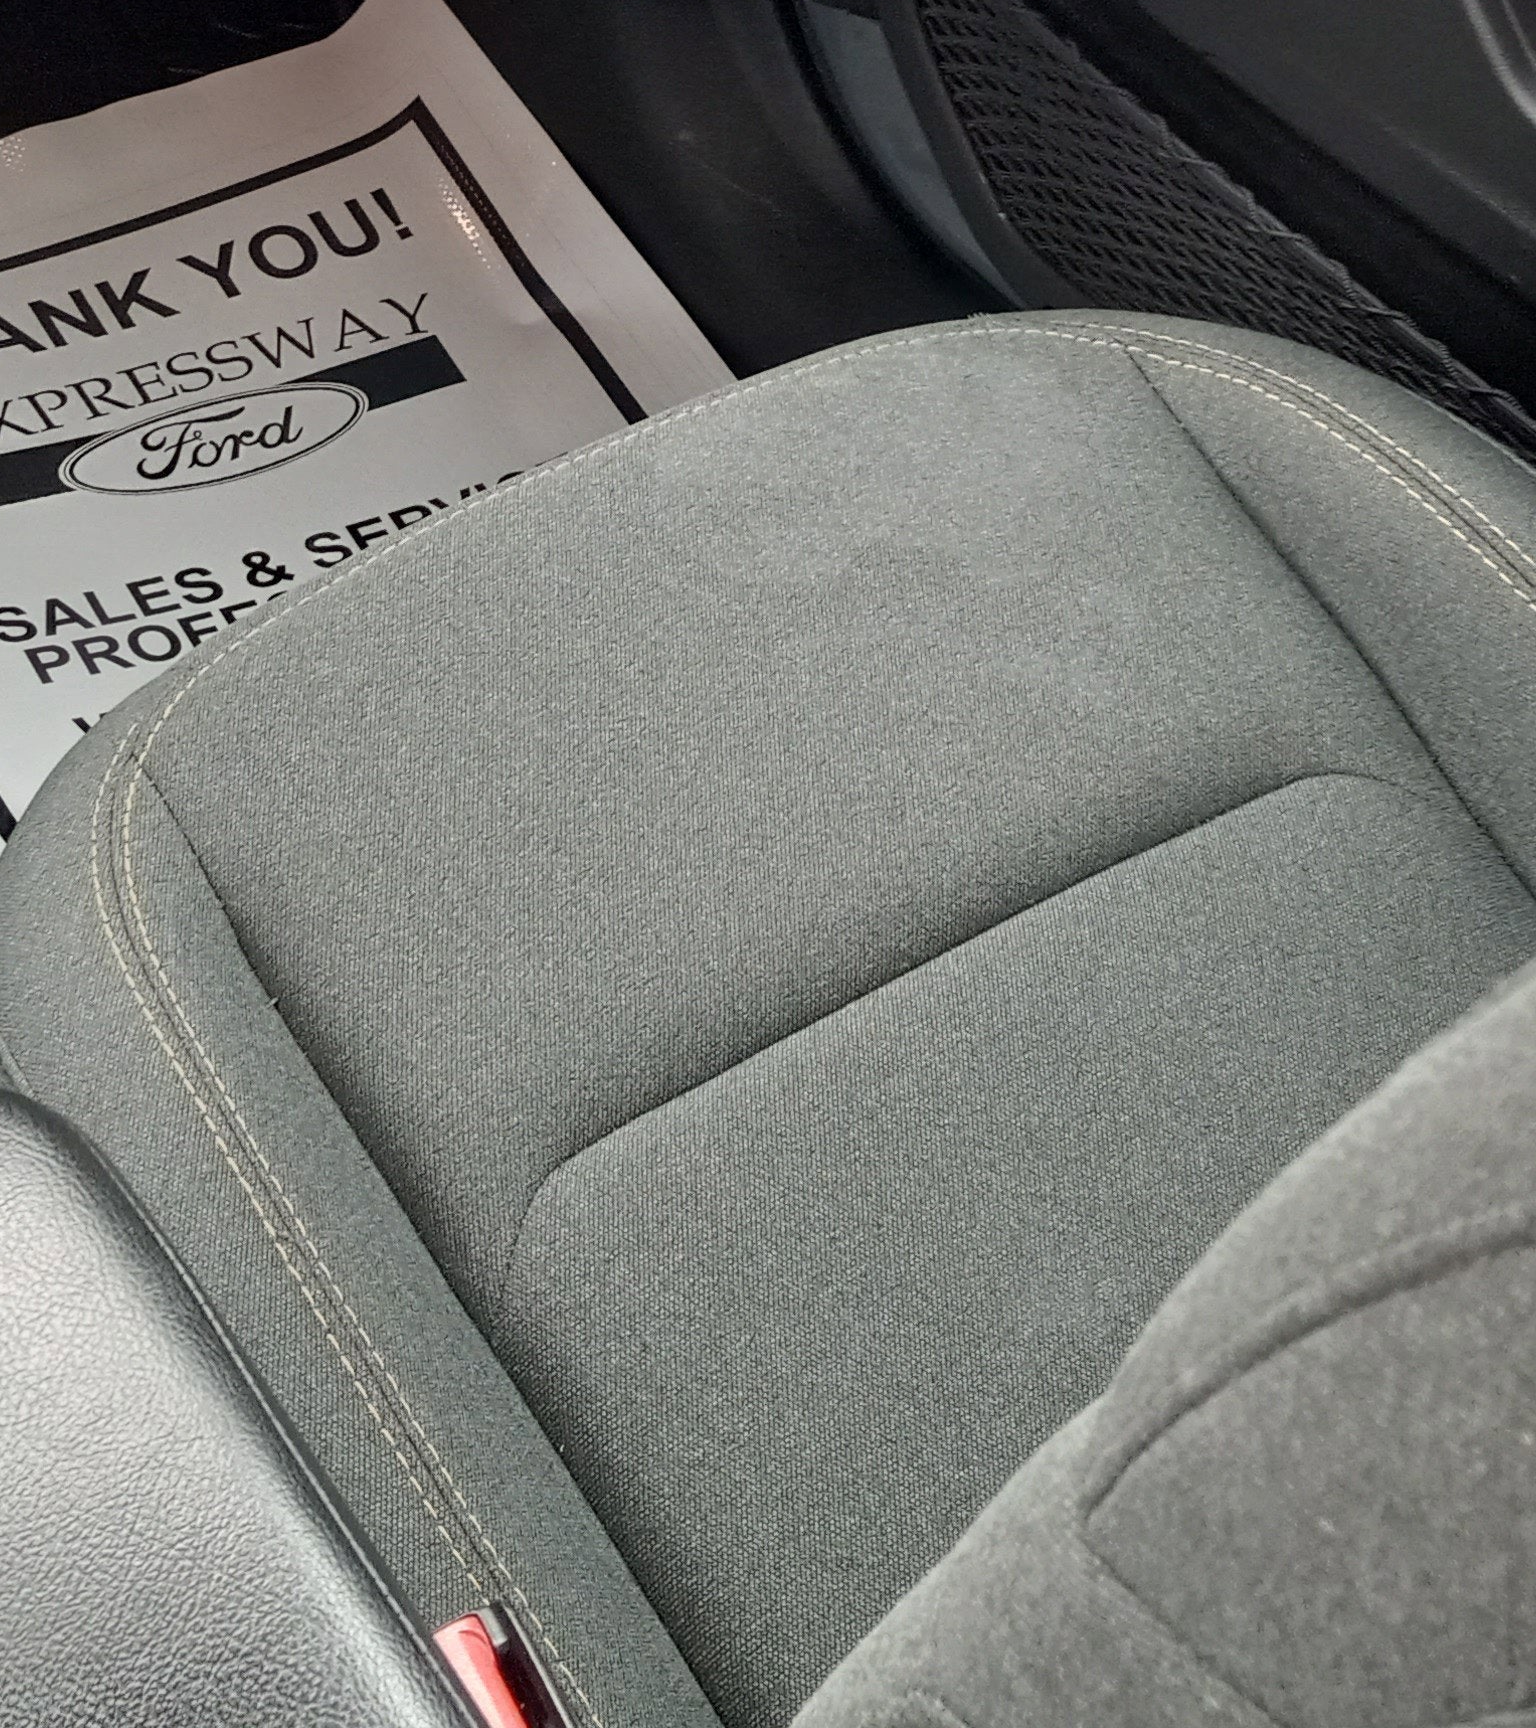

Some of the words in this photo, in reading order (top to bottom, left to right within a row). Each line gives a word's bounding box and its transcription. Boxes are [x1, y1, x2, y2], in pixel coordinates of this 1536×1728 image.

[176, 186, 415, 299] YOU!
[136, 404, 305, 481] Ford
[240, 549, 296, 589] &
[24, 589, 291, 684] PROF
